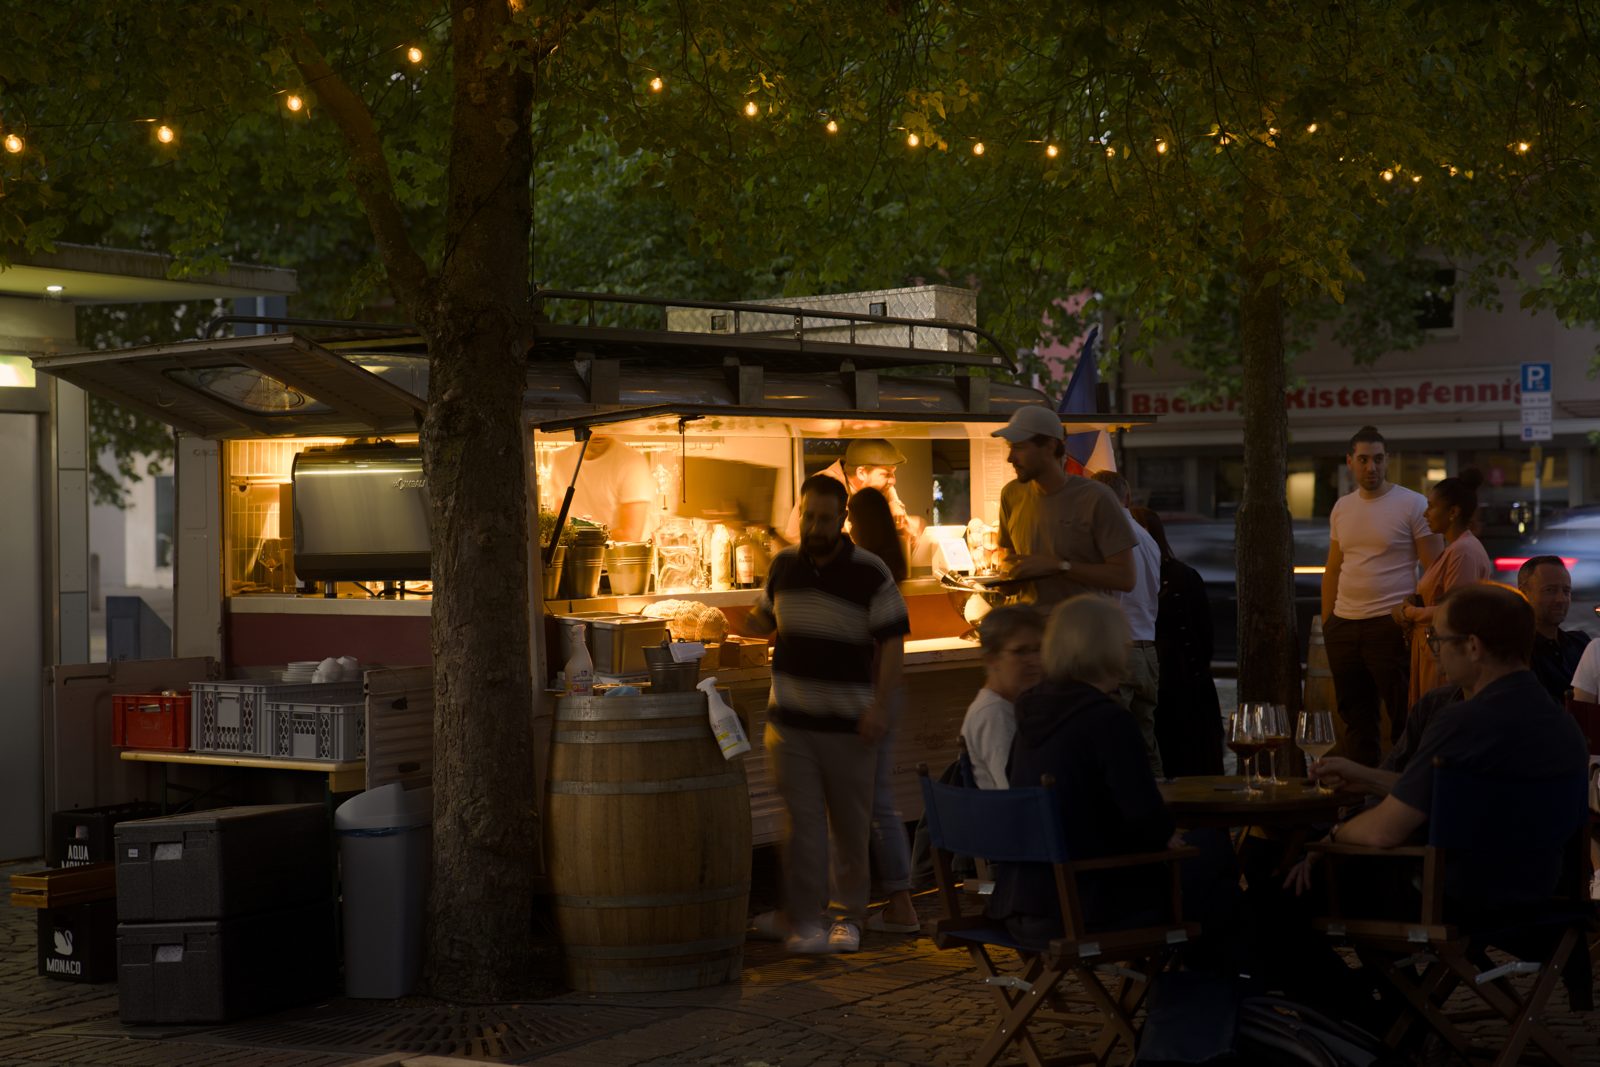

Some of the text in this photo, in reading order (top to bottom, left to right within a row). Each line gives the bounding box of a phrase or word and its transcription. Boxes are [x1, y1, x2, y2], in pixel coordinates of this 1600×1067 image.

[1527, 365, 1545, 389] P
[67, 844, 89, 861] AQUA
[47, 957, 82, 976] MONACO
